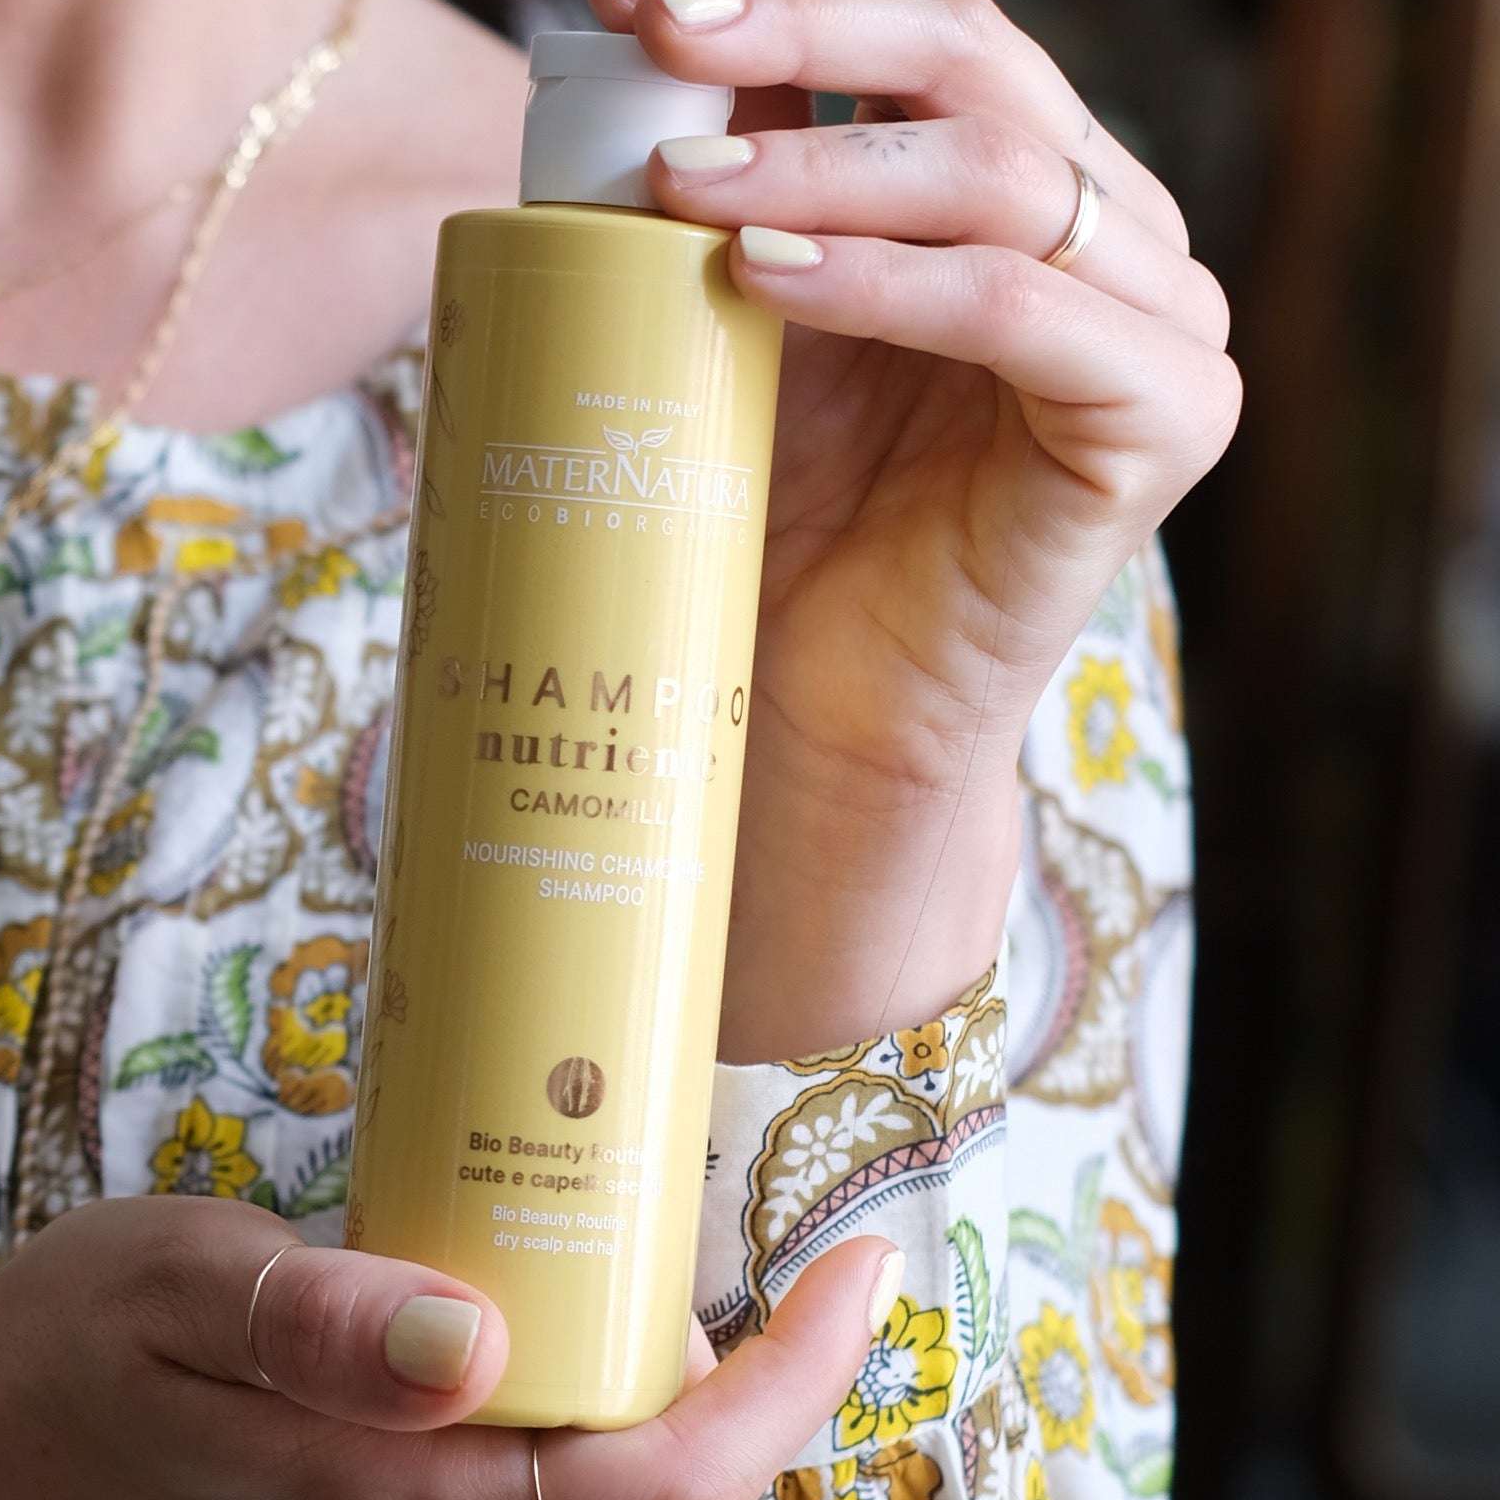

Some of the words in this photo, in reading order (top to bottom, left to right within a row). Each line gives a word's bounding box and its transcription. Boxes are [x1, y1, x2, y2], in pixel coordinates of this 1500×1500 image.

[576, 391, 626, 411] MADE
[633, 397, 651, 414] IN
[658, 400, 701, 418] ITALY
[436, 656, 744, 727] SHAMPOO
[463, 841, 595, 873] NOURISHING
[538, 878, 645, 907] SHAMPOO
[469, 1132, 502, 1153] Bio
[508, 1136, 584, 1164] Beauty
[458, 1163, 506, 1184] cute
[511, 1169, 524, 1186] e
[492, 1204, 515, 1221] Bio
[520, 1208, 571, 1229] Beauty
[576, 1213, 628, 1232] Routine
[494, 1231, 517, 1250] dry
[523, 1234, 562, 1254] scalp
[567, 1238, 593, 1253] and
[597, 1239, 621, 1256] hair
